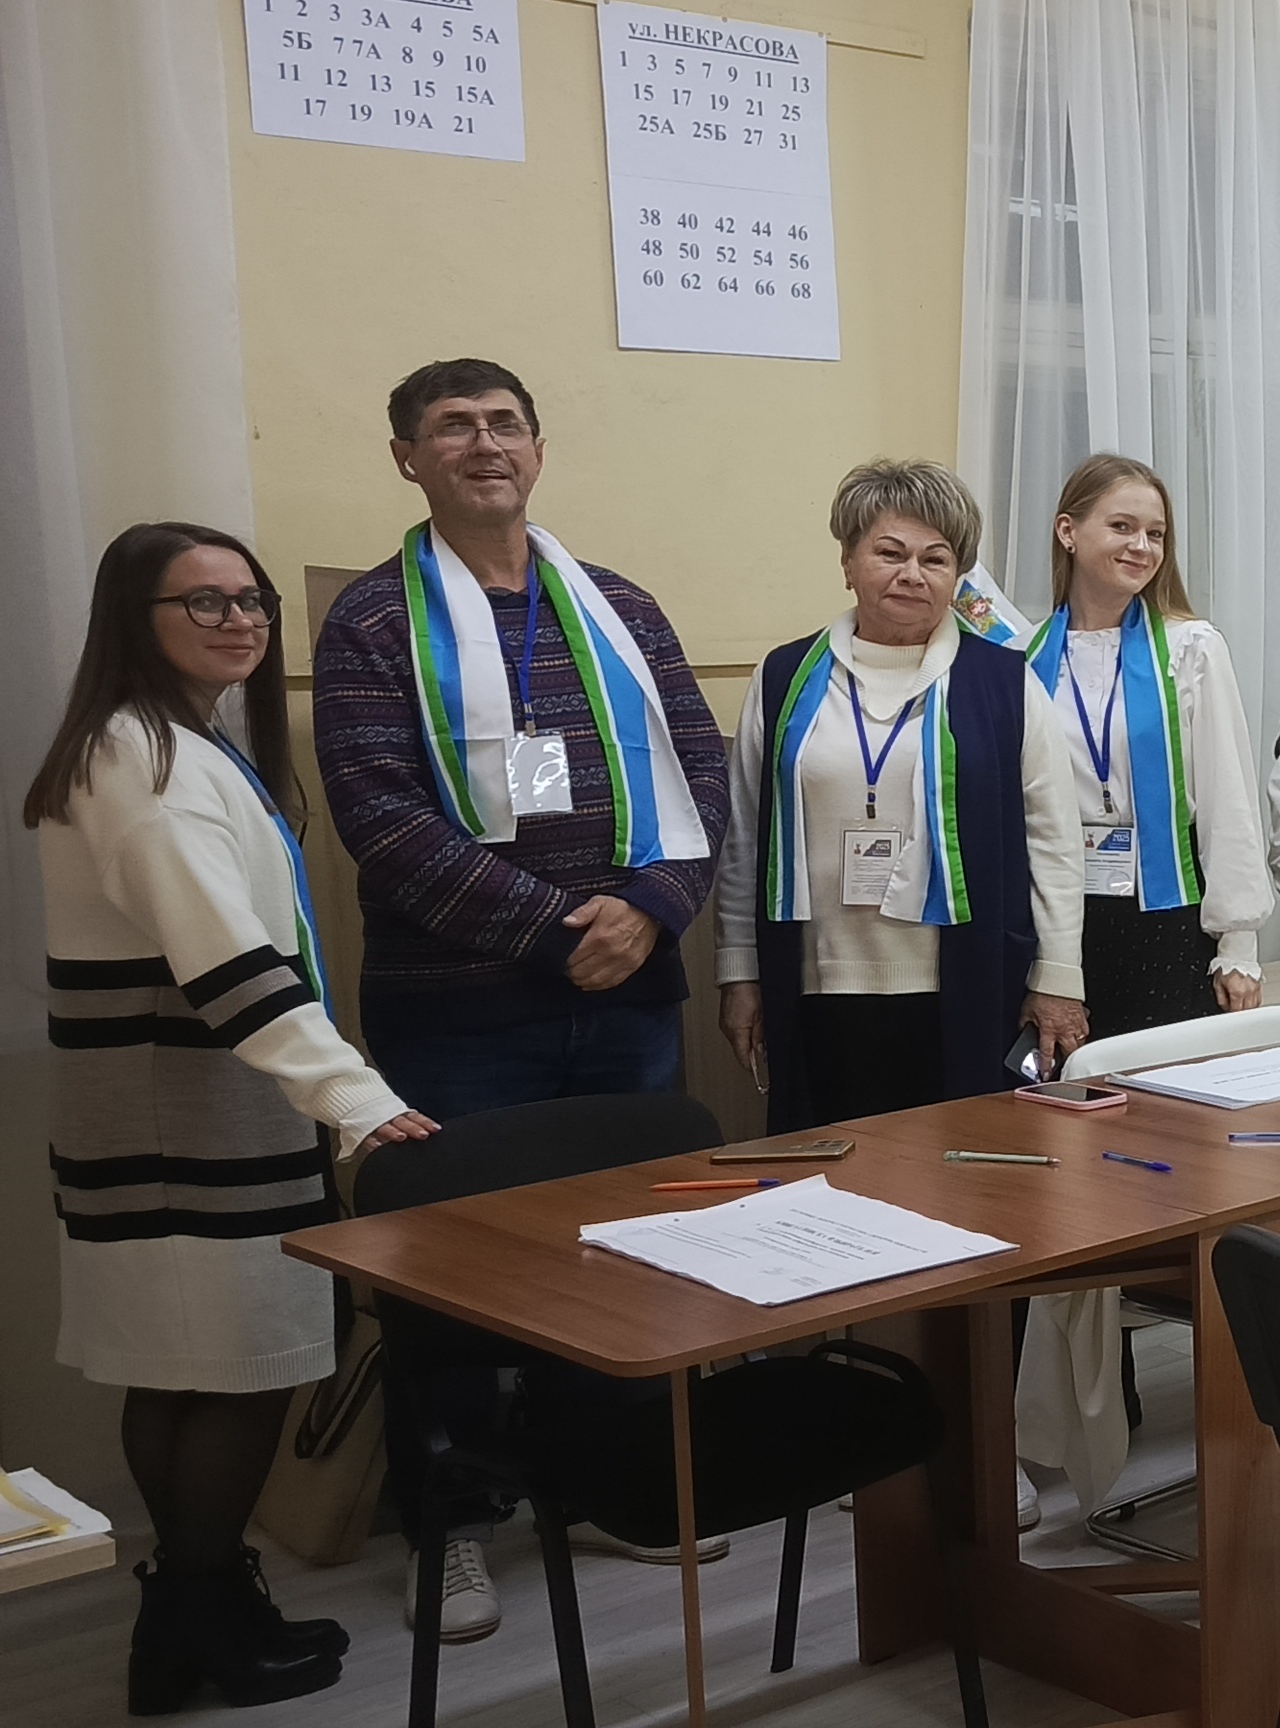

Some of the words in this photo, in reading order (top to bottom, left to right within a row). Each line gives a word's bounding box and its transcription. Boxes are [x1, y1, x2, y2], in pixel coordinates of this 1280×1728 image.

[264, 0, 273, 12] 1
[296, 0, 308, 17] 2
[329, 3, 341, 22] 3
[361, 8, 390, 29] 3А
[410, 16, 422, 33] 4
[442, 20, 453, 38] 5
[472, 24, 500, 44] 5А
[628, 22, 658, 40] ул.
[664, 24, 800, 60] НЕКРАСОВА
[282, 30, 313, 50] 5Б
[333, 36, 344, 54] 7
[352, 39, 382, 60] 7А
[402, 46, 414, 64] 8
[432, 50, 444, 67] 9
[465, 55, 487, 74] 10
[278, 62, 300, 82] 11
[325, 68, 348, 87] 12
[370, 74, 392, 93] 13
[414, 79, 436, 98] 15
[456, 85, 494, 106] 15А
[620, 50, 627, 67] 1
[647, 54, 657, 71] 3
[675, 58, 685, 75] 5
[702, 62, 712, 79] 7
[728, 66, 738, 82] 9
[755, 70, 772, 88] 11
[792, 76, 810, 94] 13
[304, 98, 327, 116] 17
[350, 103, 372, 122] 19
[394, 108, 433, 130] 19А
[453, 115, 473, 134] 21
[634, 83, 654, 102] 15
[672, 88, 692, 106] 17
[710, 94, 729, 112] 19
[746, 98, 763, 117] 21
[781, 104, 801, 122] 25
[638, 114, 675, 135] 25А
[692, 121, 727, 141] 25Б
[743, 128, 763, 145] 27
[779, 132, 796, 151] 31
[640, 208, 661, 226] 38
[677, 213, 698, 230] 40
[714, 216, 735, 234] 42
[751, 220, 772, 238] 44
[787, 224, 808, 241] 46
[640, 239, 663, 257] 48
[679, 242, 700, 260] 50
[716, 246, 737, 264] 52
[753, 249, 773, 267] 54
[789, 252, 810, 270] 56
[642, 269, 664, 287] 60
[680, 272, 702, 290] 62
[718, 276, 739, 293] 64
[754, 279, 775, 296] 66
[790, 282, 812, 299] 68
